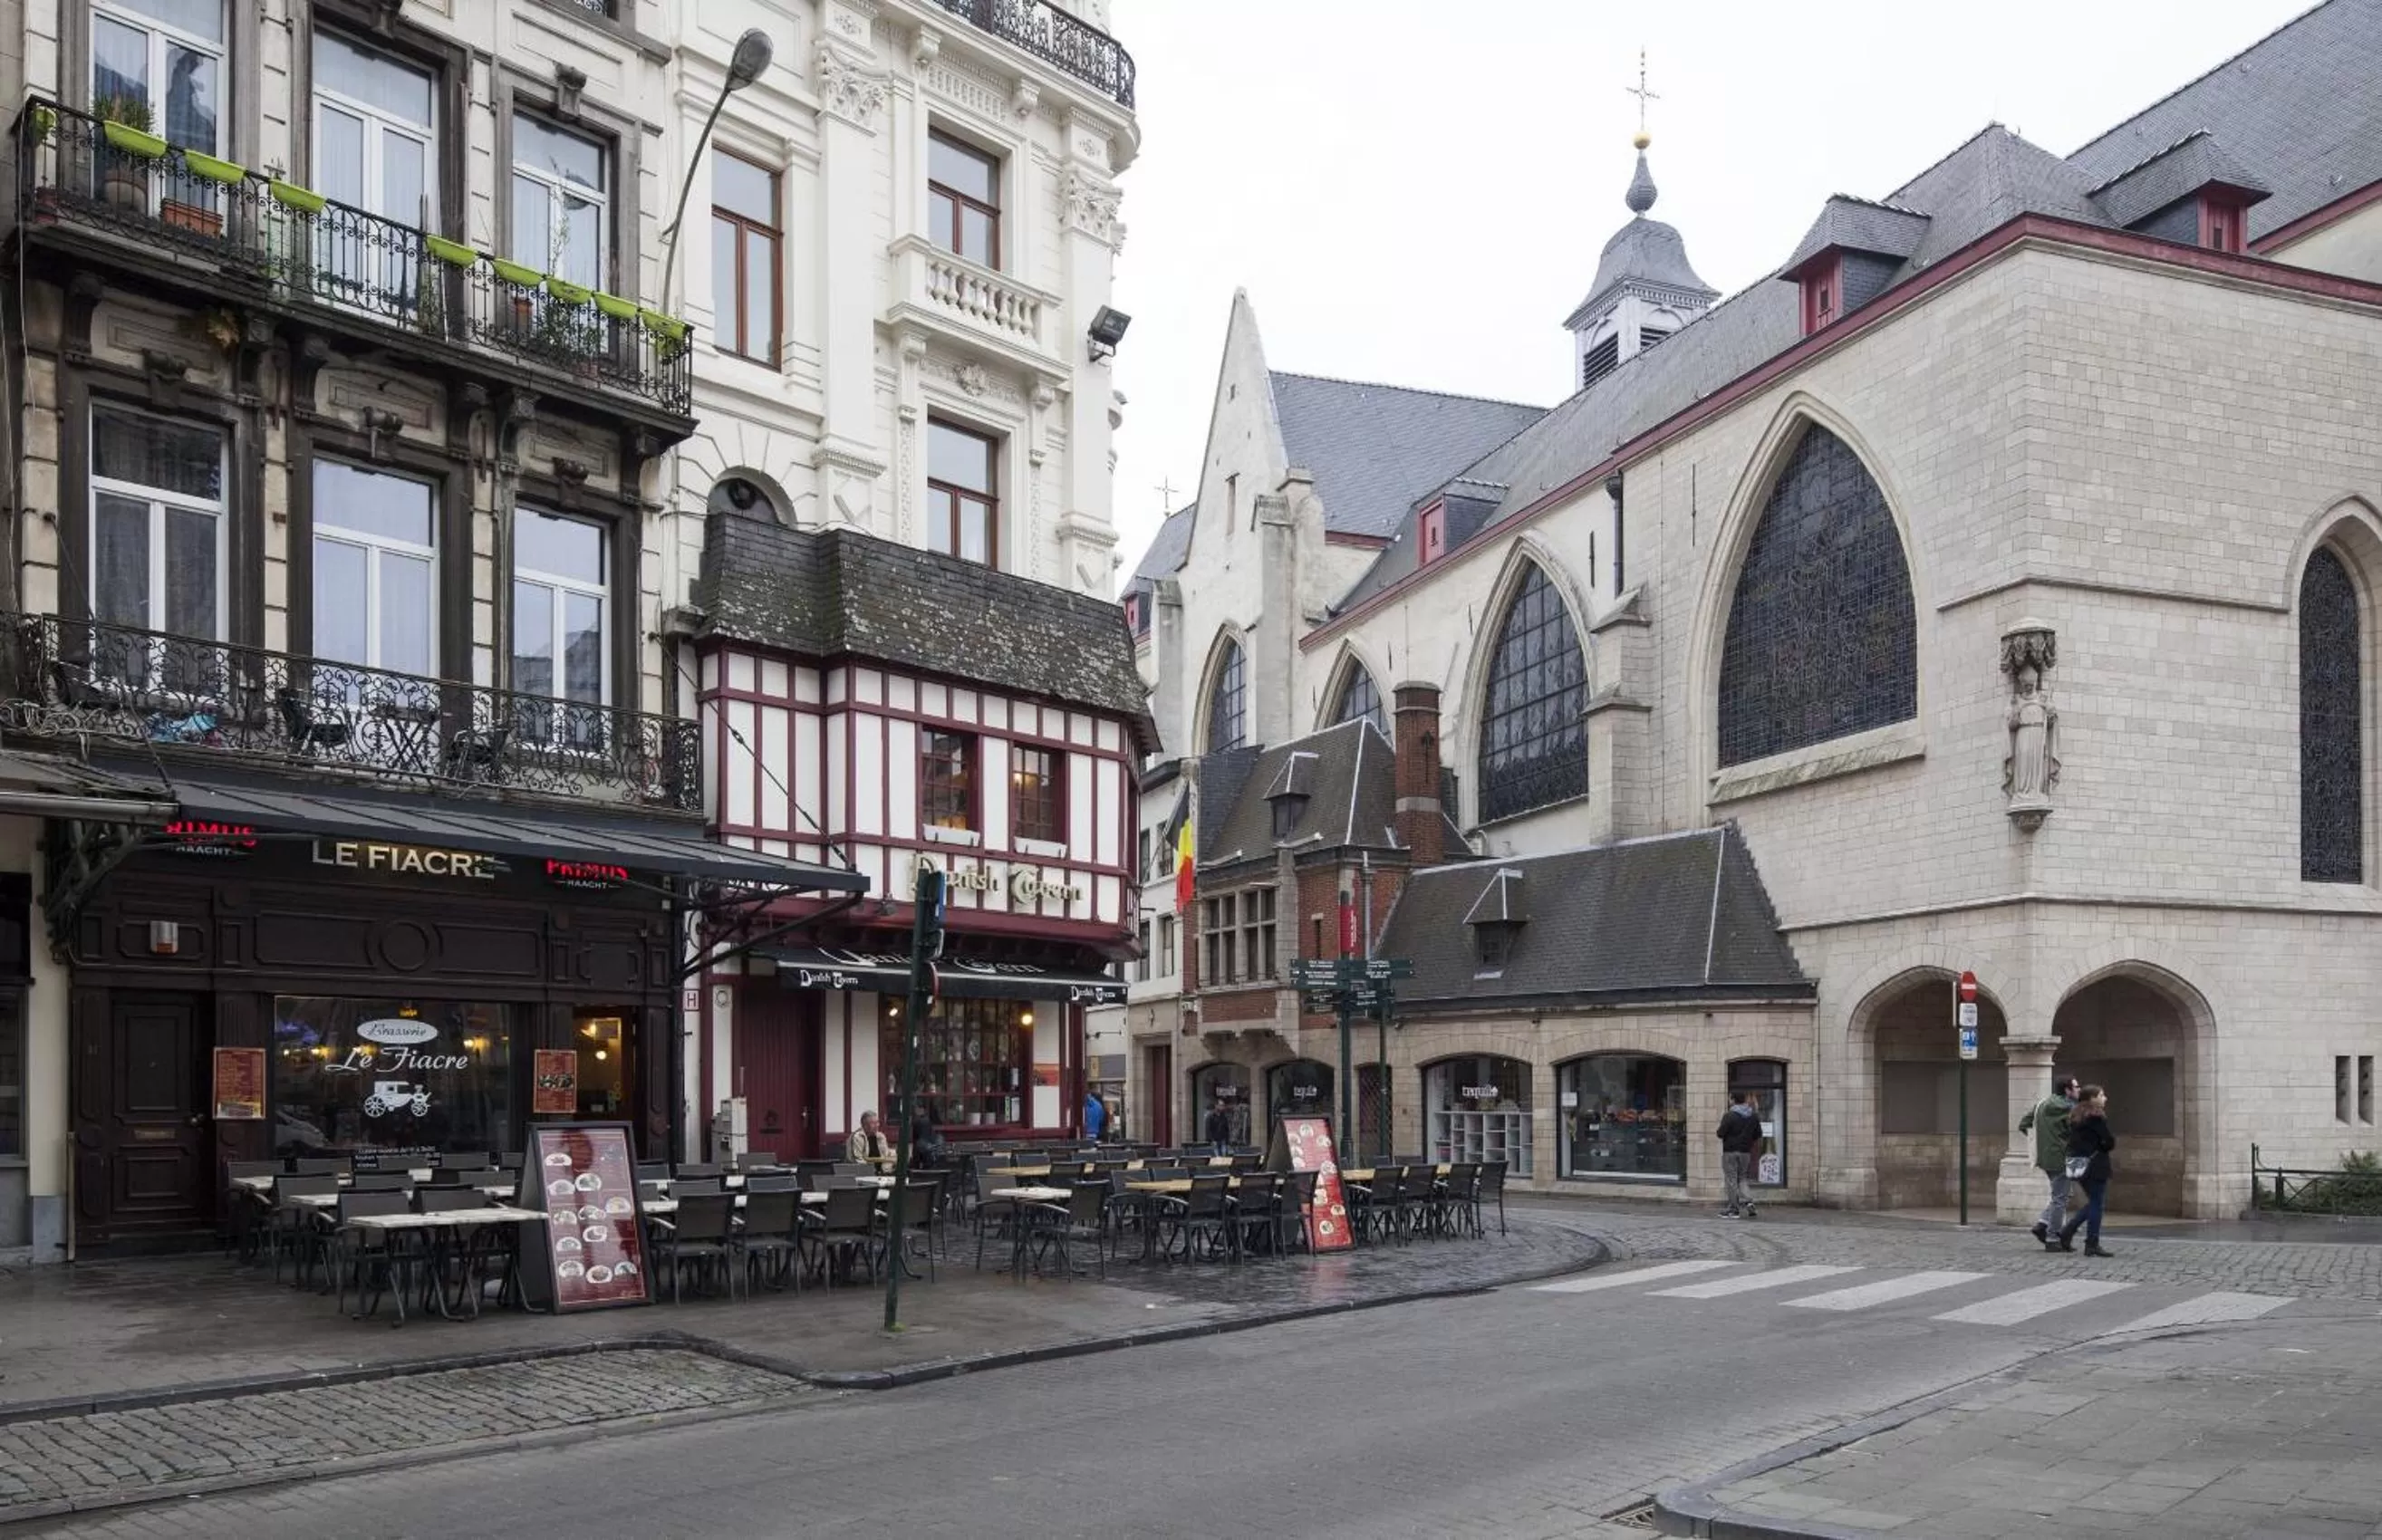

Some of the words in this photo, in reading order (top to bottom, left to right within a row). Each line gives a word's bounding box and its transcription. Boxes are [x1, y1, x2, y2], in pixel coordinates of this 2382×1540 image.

[312, 839, 359, 867] LE
[567, 879, 608, 890] HAACHT
[1009, 862, 1085, 906] Tavern
[687, 992, 697, 1008] H
[324, 1046, 373, 1072] Le
[375, 1045, 468, 1073] Fiacre
